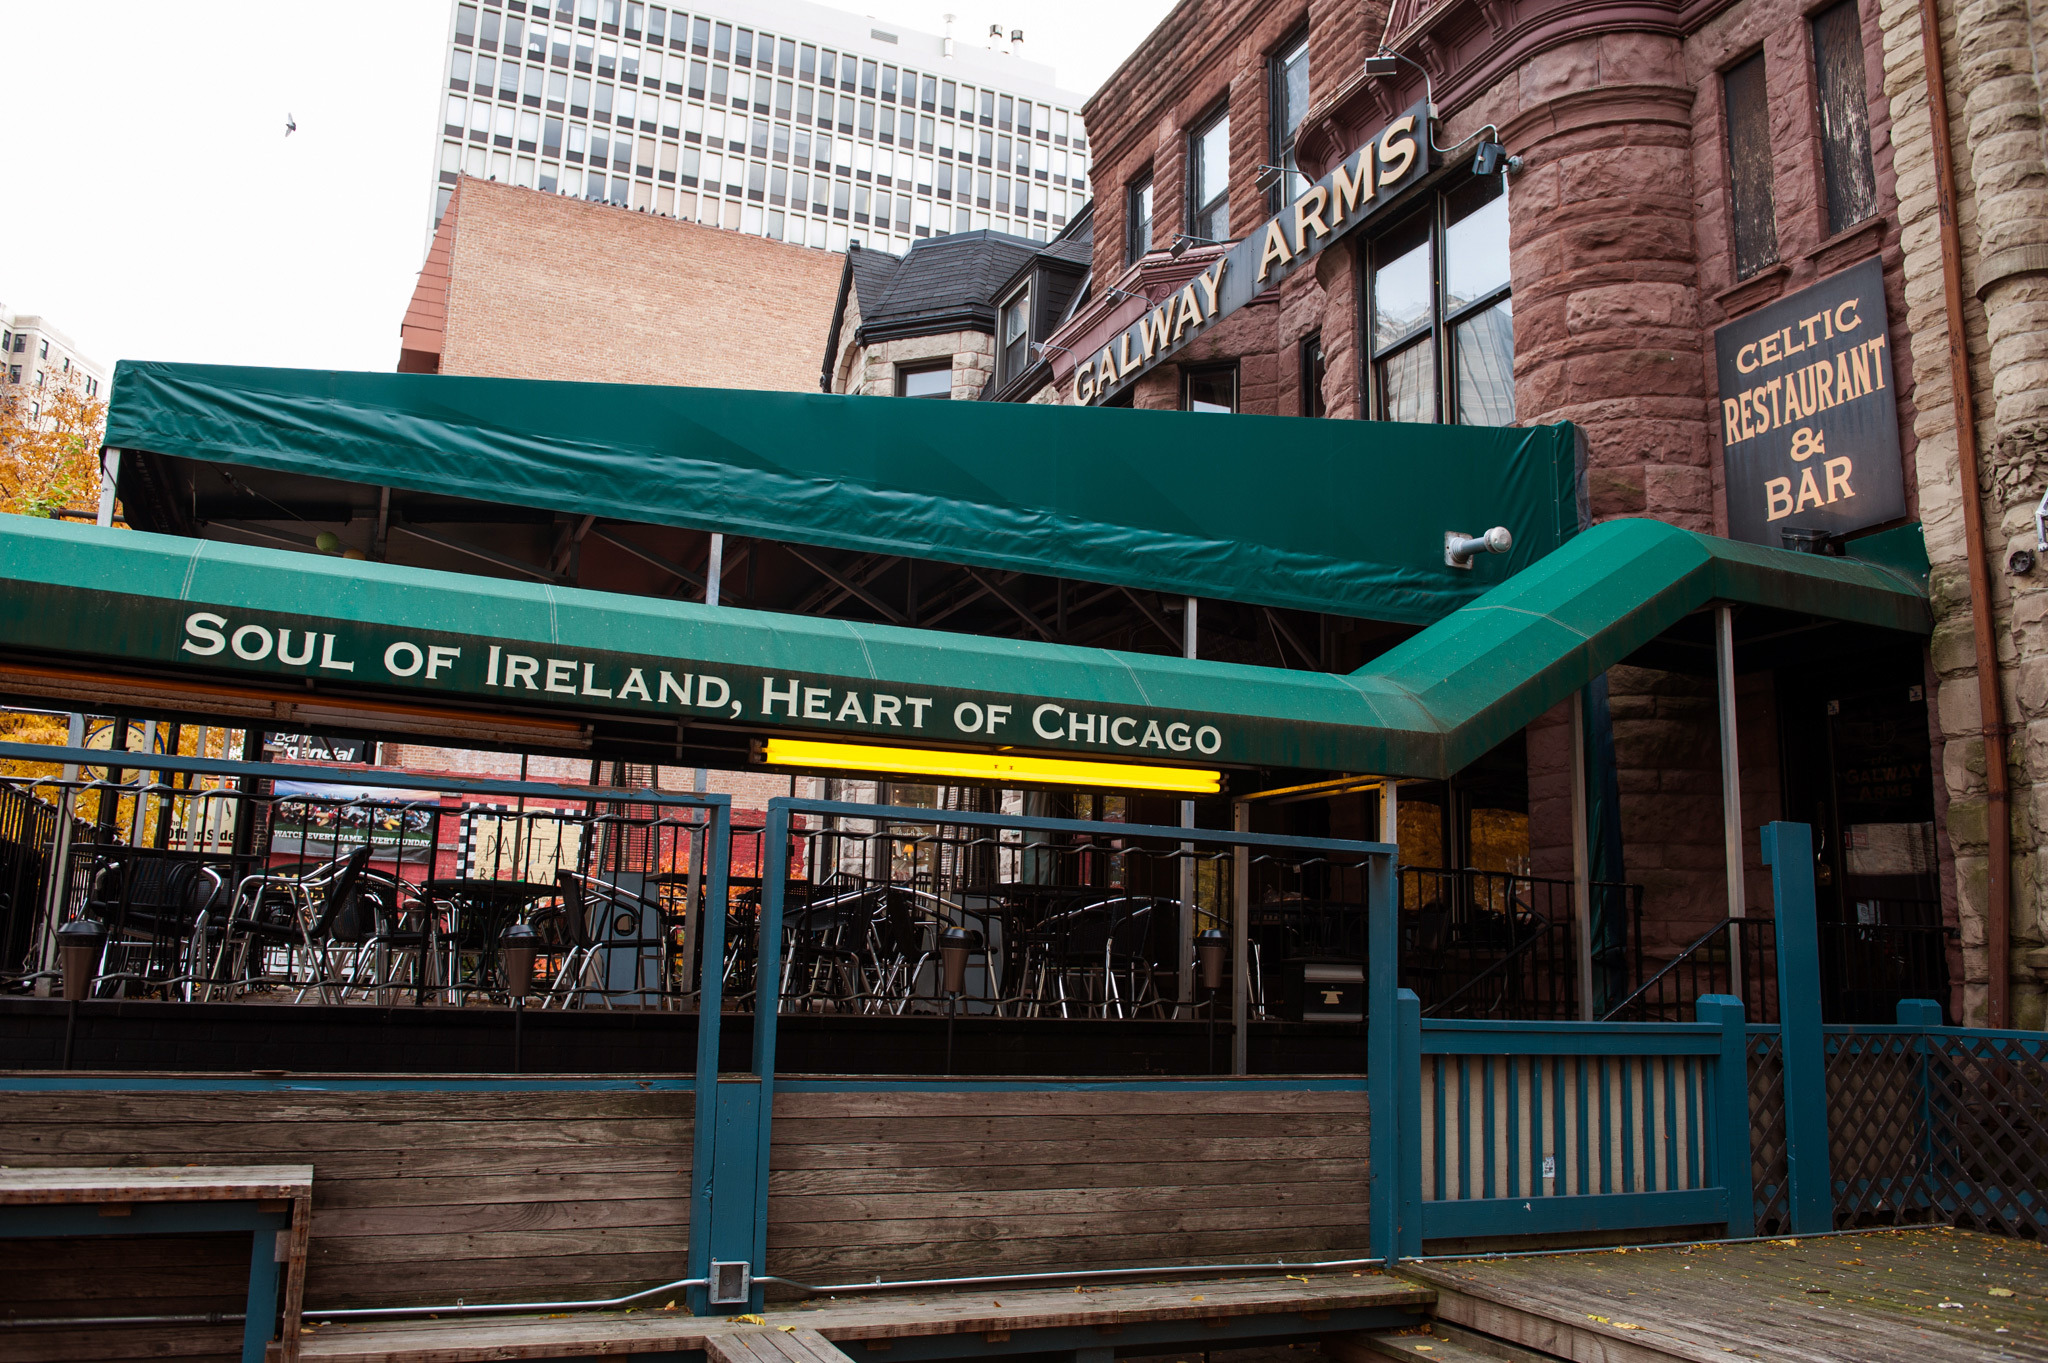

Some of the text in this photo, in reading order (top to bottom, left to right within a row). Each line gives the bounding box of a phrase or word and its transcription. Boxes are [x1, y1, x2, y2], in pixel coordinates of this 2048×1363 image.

[1073, 115, 1417, 406] GALWAY ARMS
[1736, 298, 1862, 374] CELTIC
[1722, 333, 1886, 446] RESTAURANT
[1790, 427, 1825, 462] &
[1764, 456, 1856, 522] BAR
[181, 611, 1222, 755] SOUL OF IRELAND, HEART OF CHICAGO
[96, 730, 142, 743] IMPTED
[273, 742, 355, 760] nancial
[1847, 763, 1923, 785] GALWAY
[1859, 783, 1912, 801] ARMS
[169, 828, 235, 842] Othr Sde
[273, 830, 304, 838] WATCH
[307, 832, 336, 840] EVERY
[486, 835, 565, 866] PASTA
